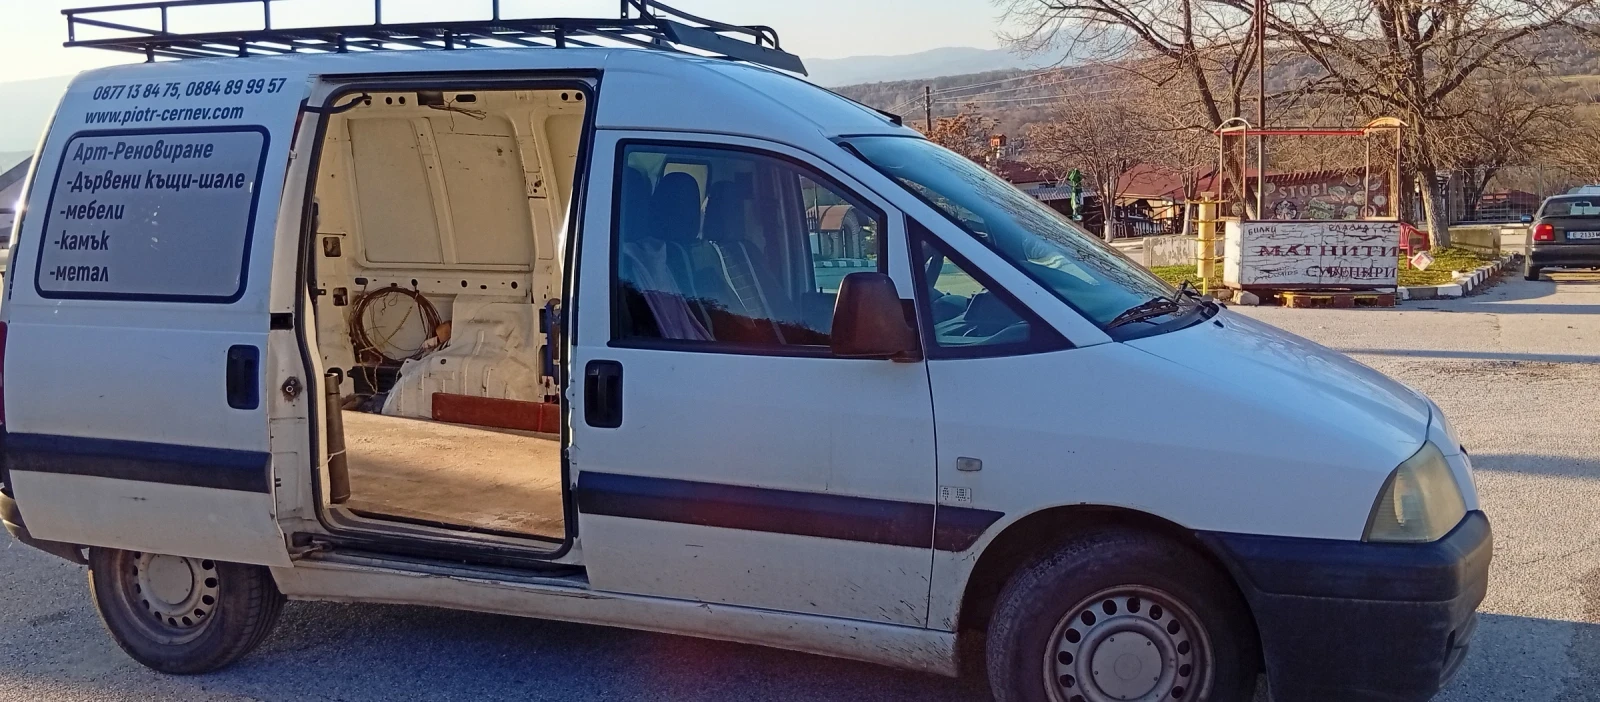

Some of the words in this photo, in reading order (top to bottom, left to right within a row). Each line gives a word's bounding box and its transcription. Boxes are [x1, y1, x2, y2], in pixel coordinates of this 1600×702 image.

[93, 85, 126, 100] 0877
[126, 84, 142, 99] 13
[142, 83, 161, 98] 84
[162, 82, 181, 100] 75,
[185, 80, 221, 97] 0884
[223, 79, 244, 95] 89
[245, 78, 266, 94] 99
[267, 77, 287, 93] 57
[85, 106, 244, 126] www.piotr-cernev.com
[73, 140, 214, 164] Арт-Реновиране
[67, 170, 141, 194] -Дървени
[144, 169, 245, 191] къщи-шале
[1279, 183, 1327, 199] STOBI
[60, 200, 124, 220] -мебели
[54, 230, 110, 250] -камък
[1258, 244, 1398, 256] МАГНИТИ
[49, 265, 109, 282] -метал
